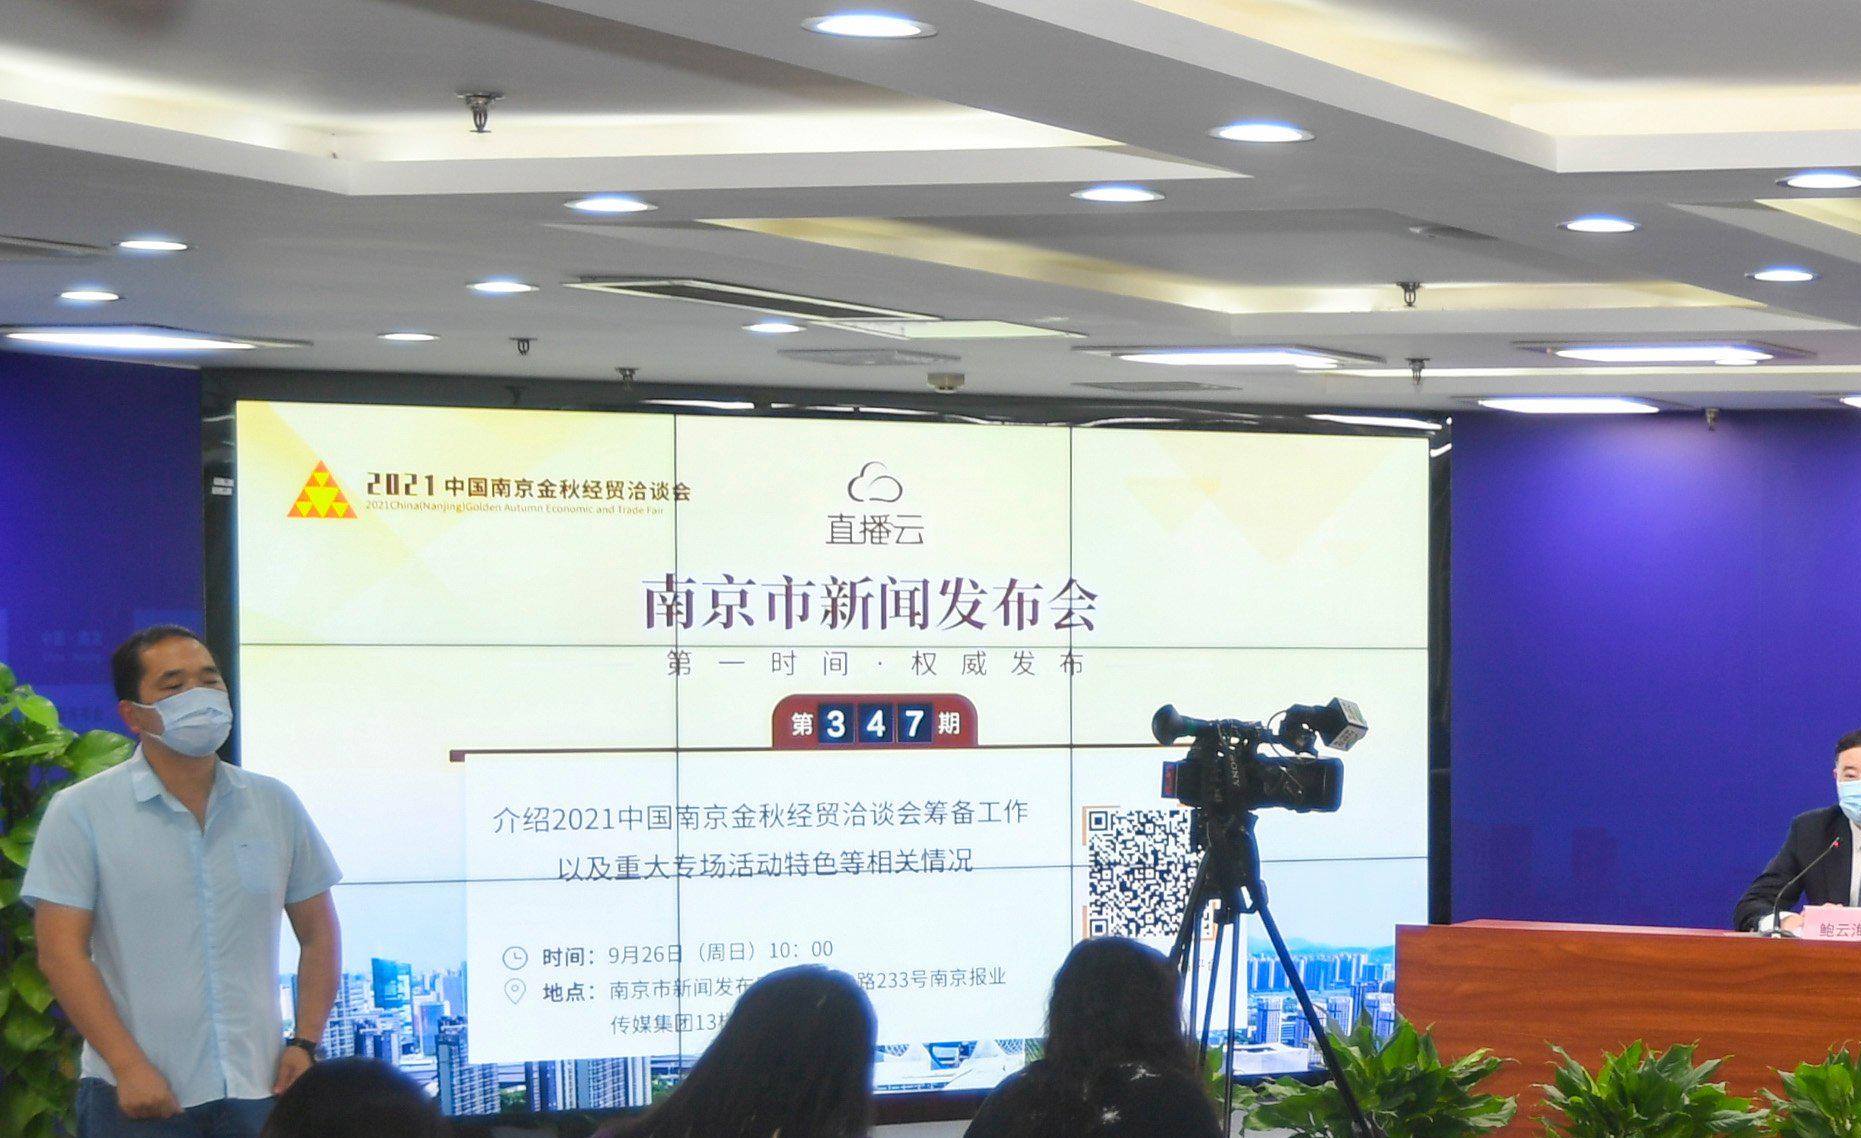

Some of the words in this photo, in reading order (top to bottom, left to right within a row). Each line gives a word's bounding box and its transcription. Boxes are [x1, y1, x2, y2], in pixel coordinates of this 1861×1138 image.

[504, 503, 543, 514] Autumn
[546, 504, 593, 515] Economic
[596, 504, 615, 515] and
[617, 505, 645, 516] Trade
[826, 513, 925, 545] 直播云
[641, 573, 1098, 631] 南京市新闻发布会
[493, 799, 1029, 834] 介绍2021中国南京金秋经贸洽谈会筹备工作
[558, 847, 974, 882] 以及重大专场活动特色等相关情况
